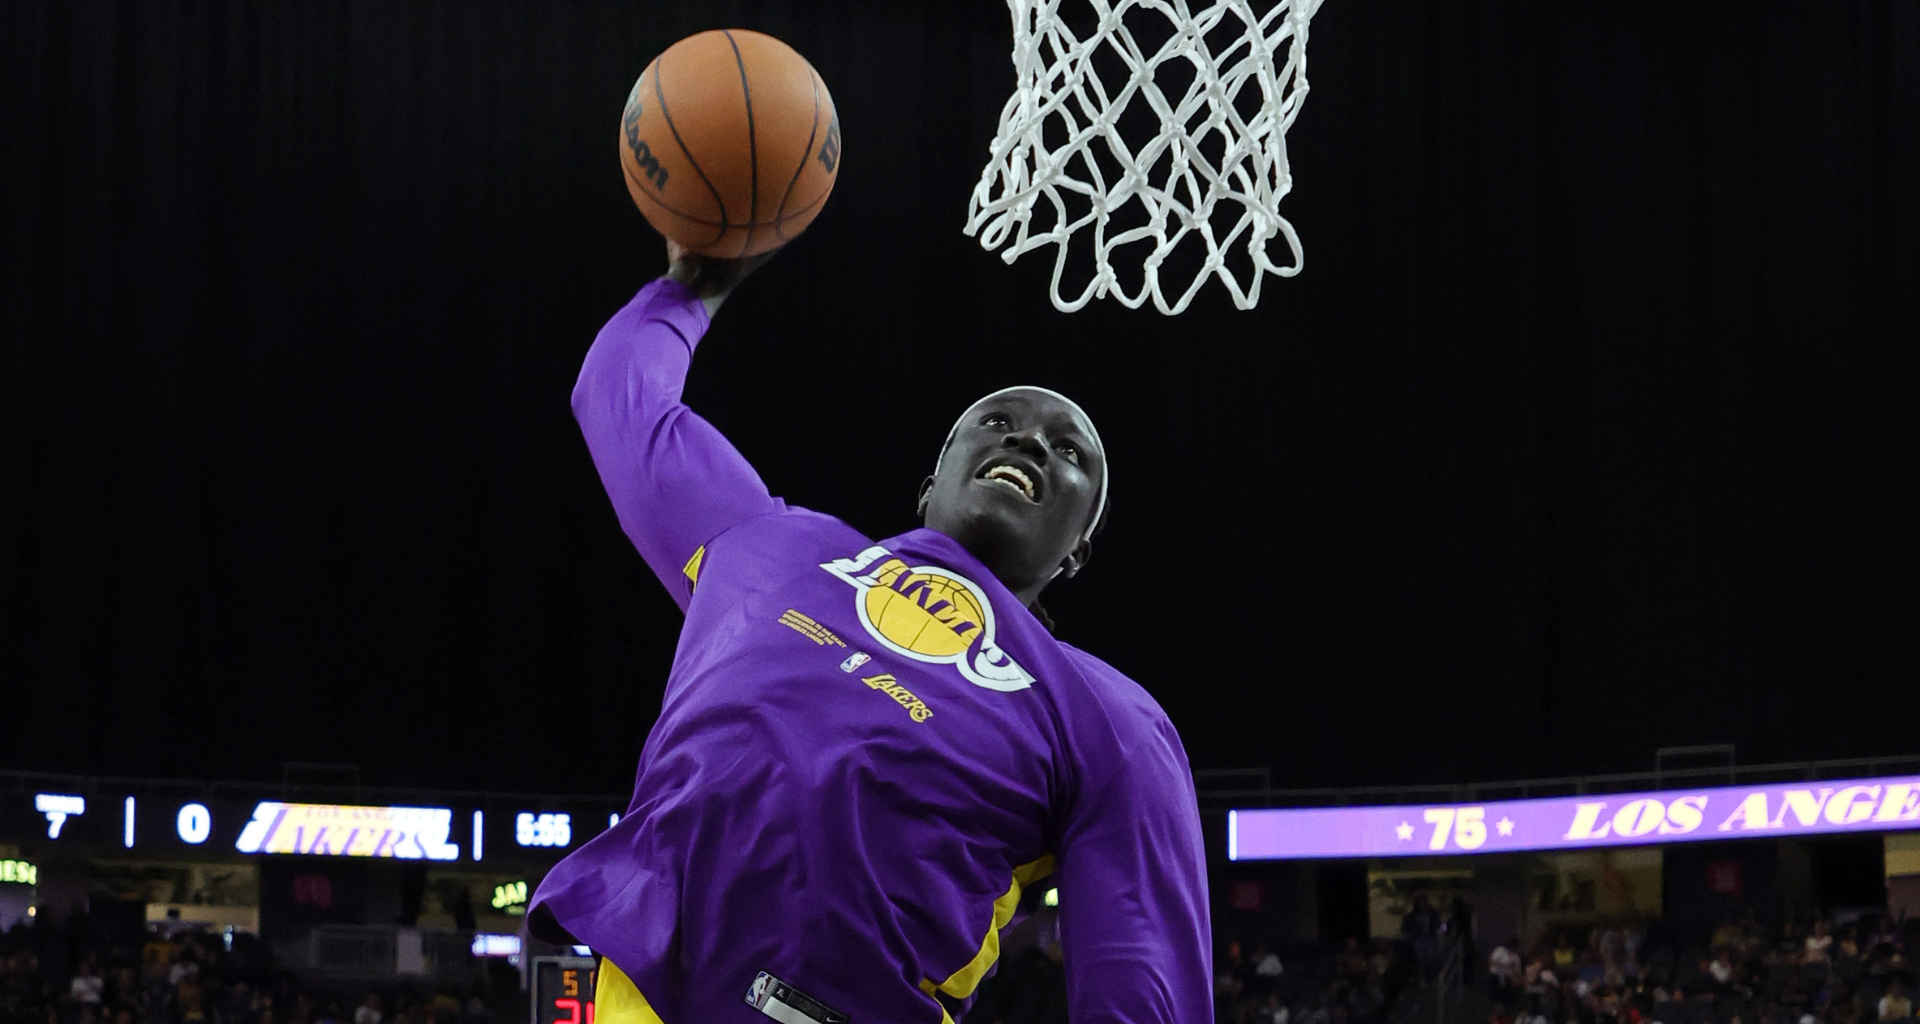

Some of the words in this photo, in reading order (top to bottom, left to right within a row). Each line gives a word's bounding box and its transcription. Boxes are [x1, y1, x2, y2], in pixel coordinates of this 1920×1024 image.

[861, 673, 934, 723] LAKERS
[46, 812, 67, 839] 7
[177, 803, 211, 844] 0
[1424, 806, 1487, 851] 75
[1563, 795, 1708, 841] LOS
